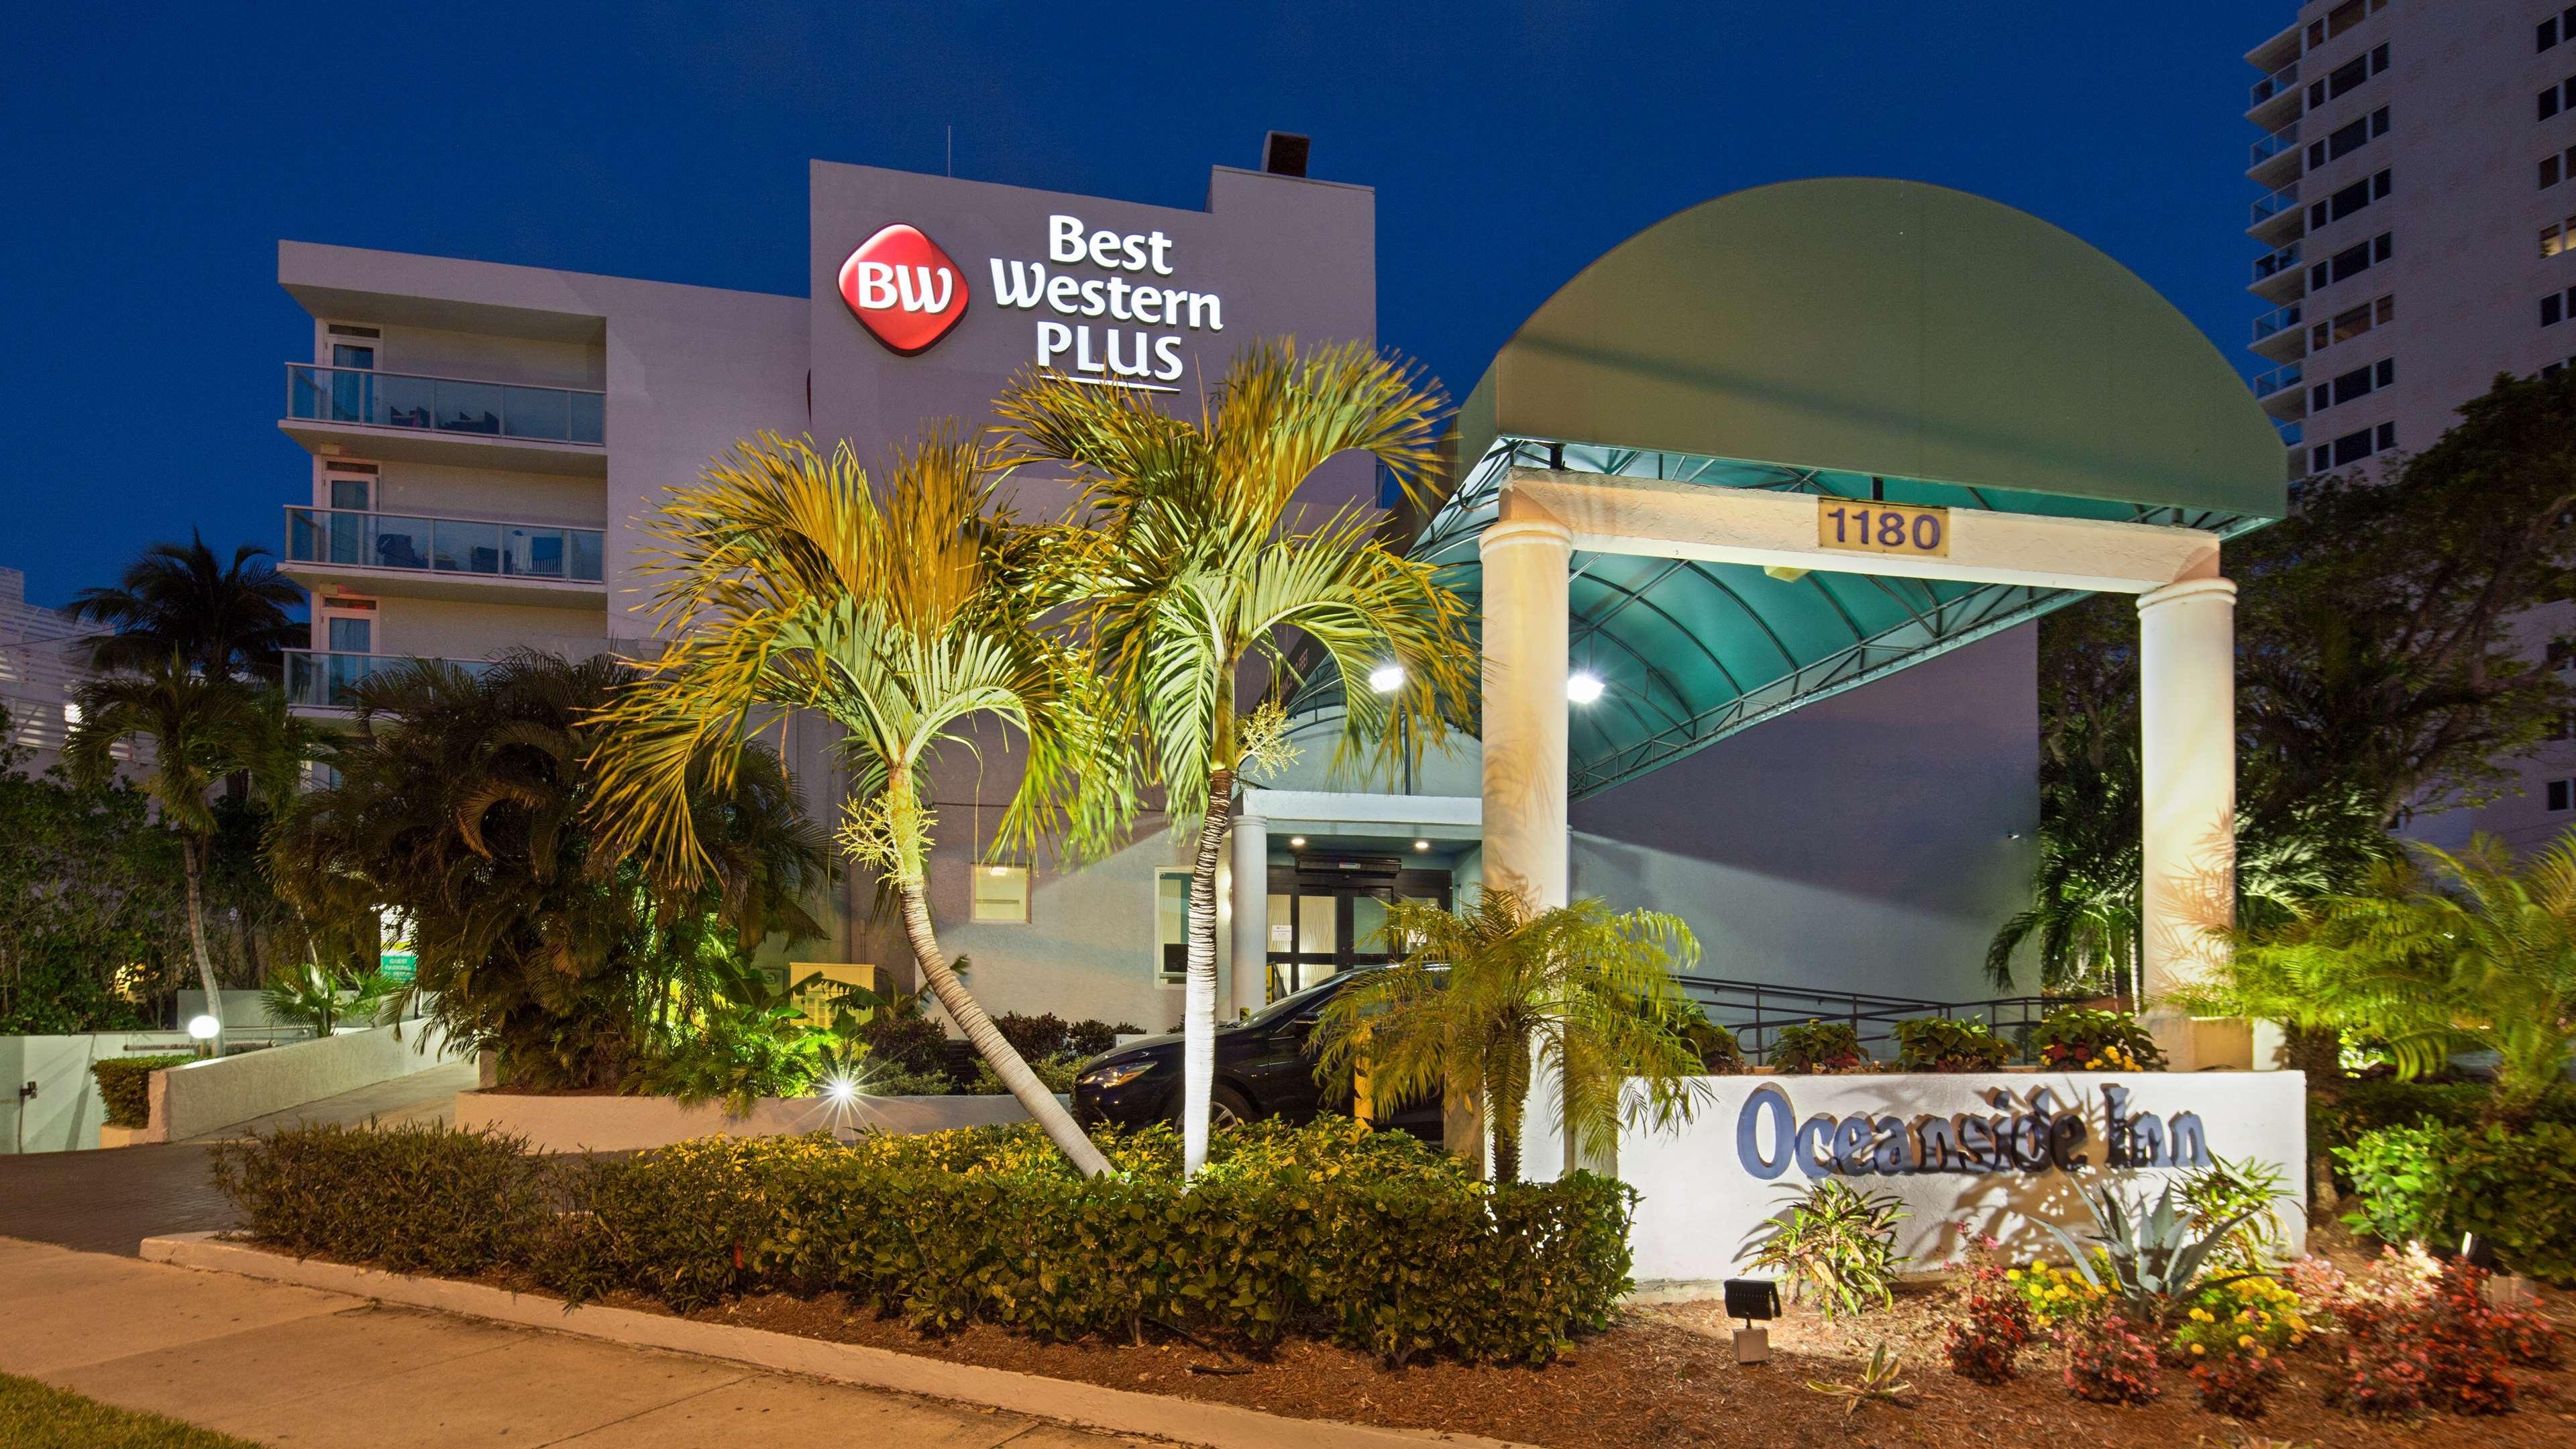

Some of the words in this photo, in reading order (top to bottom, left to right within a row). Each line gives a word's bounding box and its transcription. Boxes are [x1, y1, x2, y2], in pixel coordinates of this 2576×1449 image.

[1049, 215, 1173, 276] Best
[857, 261, 953, 314] BW
[989, 258, 1224, 331] Western
[1036, 321, 1183, 381] PLUS
[1827, 508, 1941, 550] 1180
[1736, 1081, 2088, 1180] Oceanside
[2099, 1082, 2212, 1170] Inn
